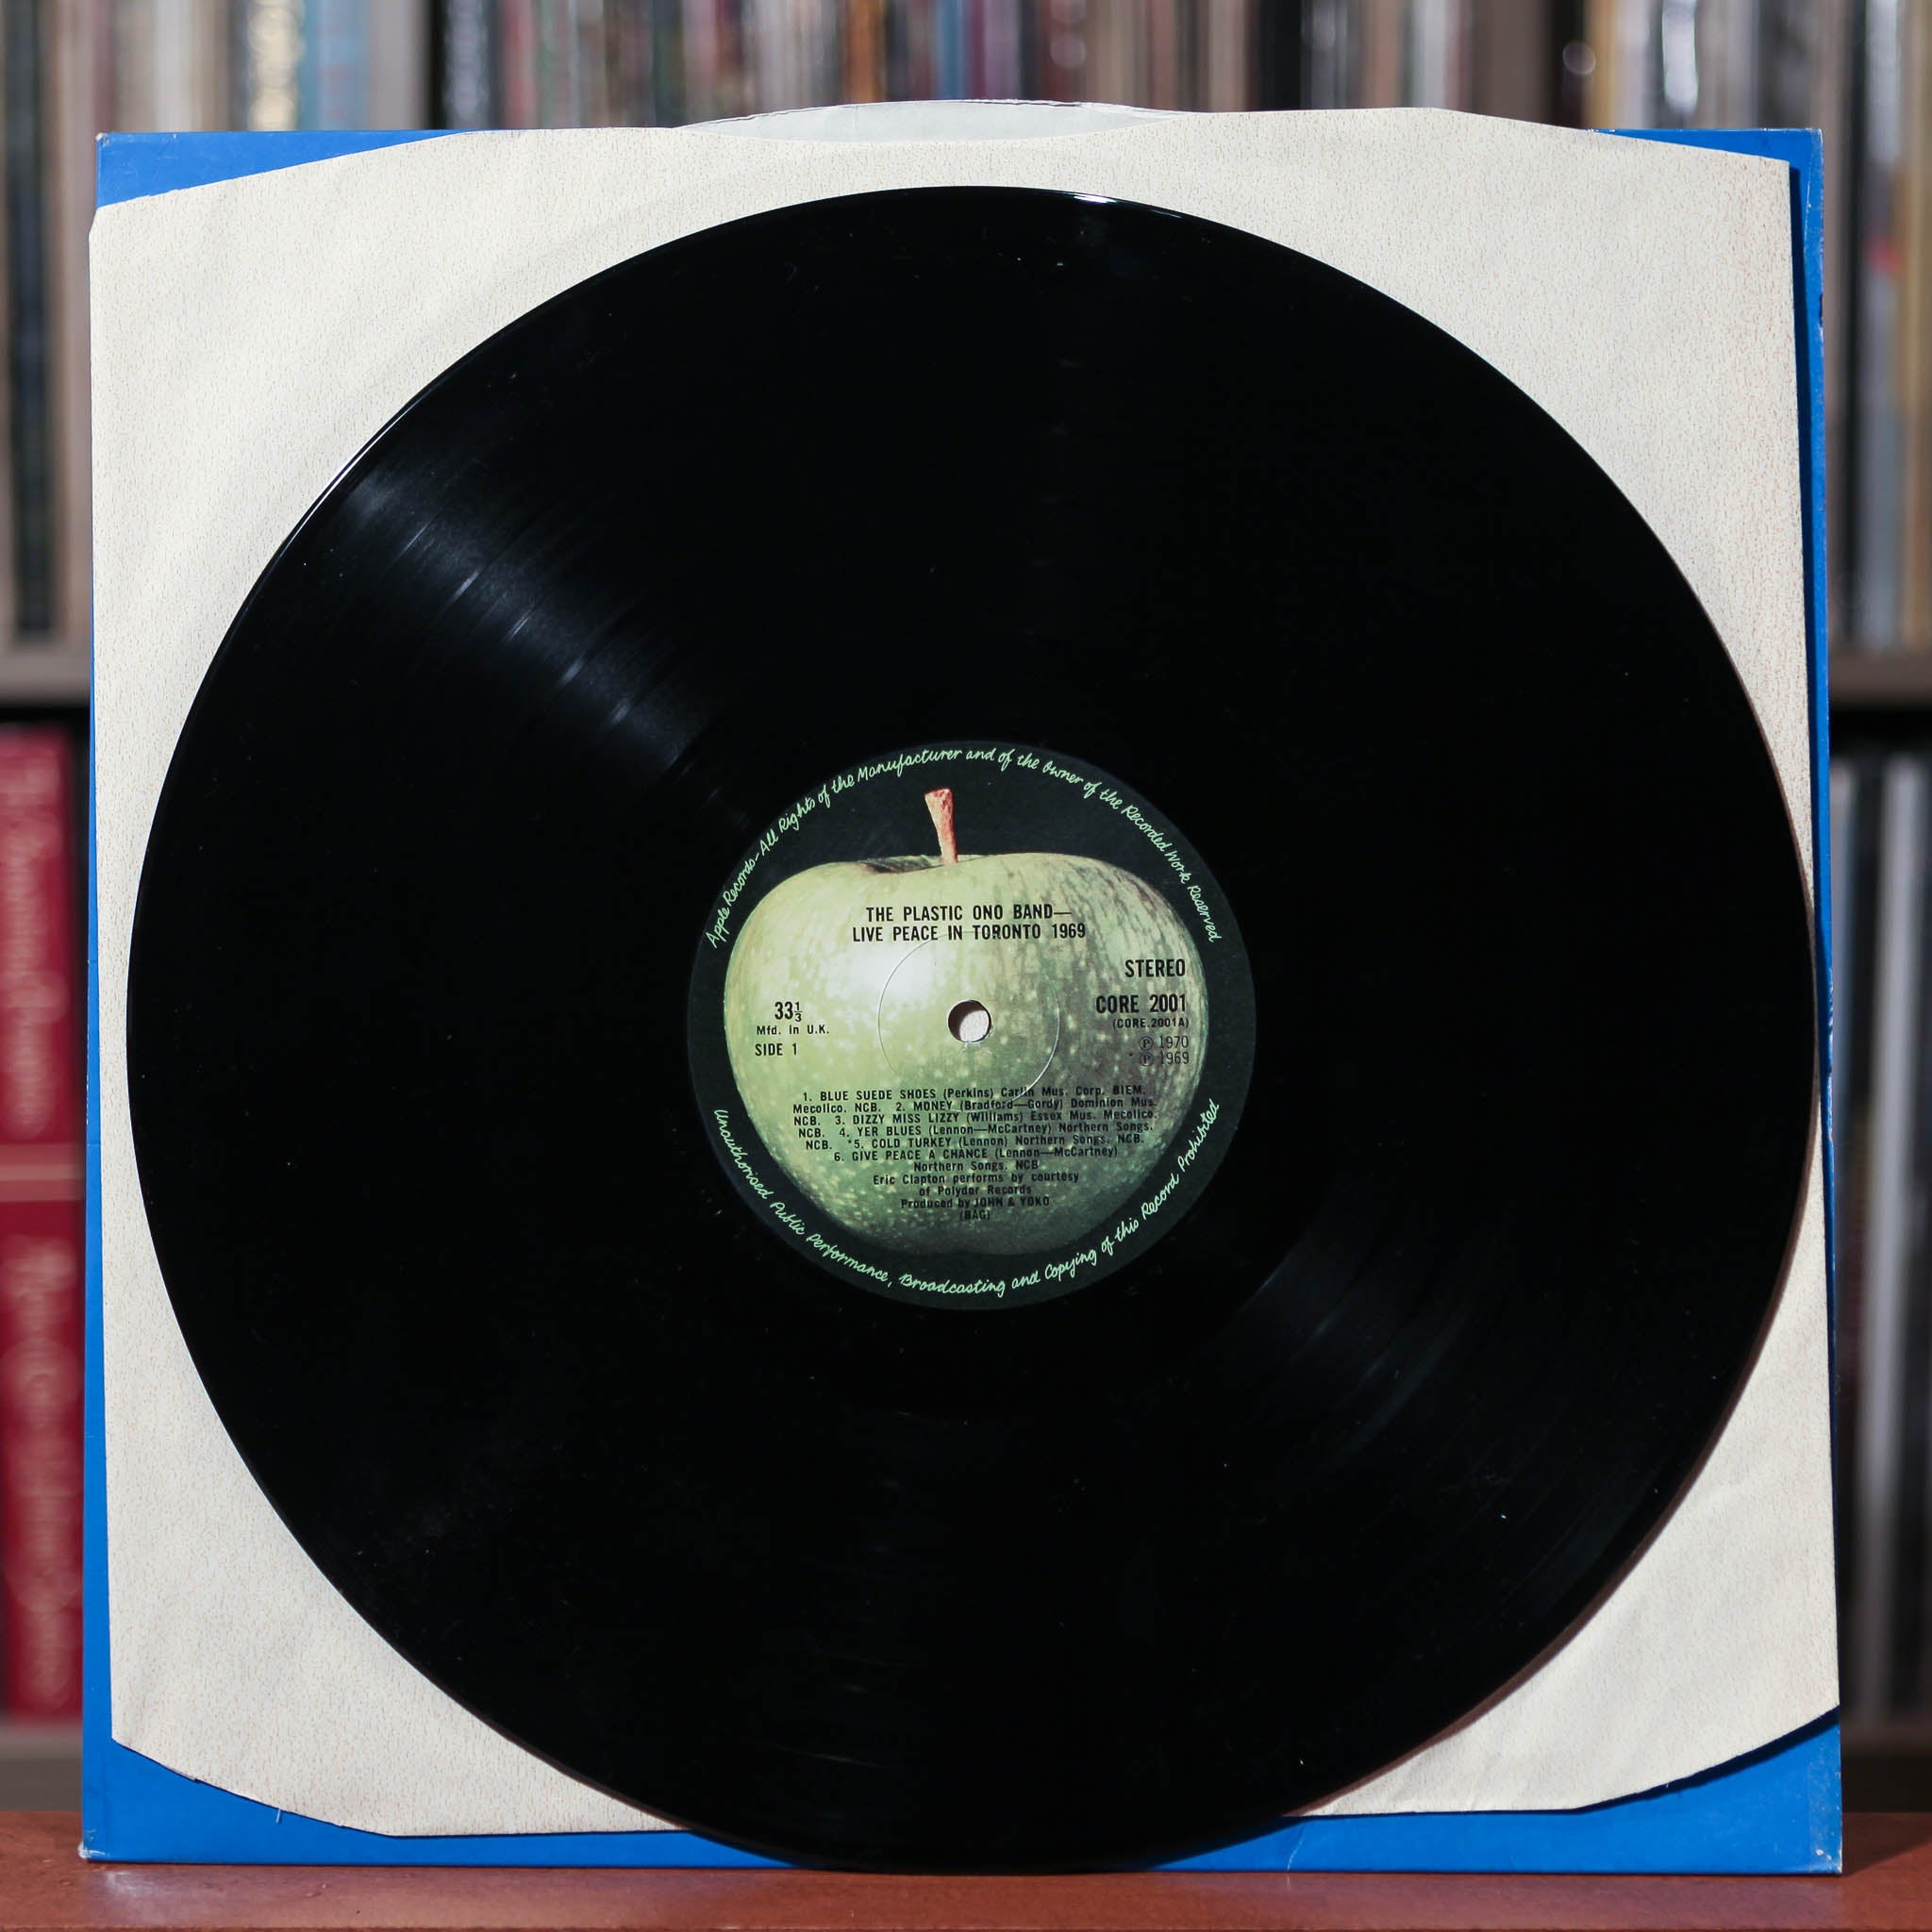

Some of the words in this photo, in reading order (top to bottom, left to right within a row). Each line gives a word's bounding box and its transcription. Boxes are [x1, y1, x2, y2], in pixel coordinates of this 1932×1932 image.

[706, 907, 730, 949] Apple
[778, 797, 816, 833] Rights
[818, 784, 831, 808] of
[831, 774, 855, 794] the
[858, 749, 964, 782] Manufacturer
[966, 747, 994, 761] and
[998, 748, 1016, 772] of
[1017, 753, 1040, 771] the
[1042, 760, 1084, 784] Owner
[1084, 781, 1102, 799] of
[1100, 789, 1123, 809] the
[1121, 805, 1166, 853] Recorded
[1164, 843, 1191, 884] Work
[1187, 885, 1223, 942] Reserved
[866, 907, 893, 923] THE
[903, 905, 963, 922] PLASTIC
[973, 904, 1004, 920] ONO
[852, 926, 883, 942] LIVE
[892, 924, 939, 941] PEACE
[948, 924, 963, 941] IN
[972, 924, 1041, 941] TORONTO
[1051, 922, 1086, 939] 1969
[1124, 958, 1186, 977] STEREO
[1095, 994, 1141, 1014] CORE
[1149, 992, 1186, 1012] 2001
[756, 1025, 781, 1036] Mfd.
[807, 1024, 830, 1035] U.K.
[755, 1042, 784, 1056] SIDE
[791, 1042, 798, 1056] 1
[1158, 1035, 1190, 1049] 1970
[1159, 1050, 1190, 1065] 1969
[803, 1091, 812, 1102] 1.
[820, 1091, 849, 1101] BLUE
[856, 1090, 892, 1100] SUEDE
[899, 1089, 937, 1099] SHOES
[943, 1087, 994, 1100] (Perkins)
[1041, 1086, 1068, 1097] Mus.
[1075, 1086, 1106, 1099] Corp.
[1112, 1085, 1146, 1096] BIEM.
[854, 1102, 881, 1113] NCB.
[895, 1101, 906, 1112] 2.
[913, 1101, 953, 1111] MONEY
[1071, 1097, 1124, 1108] Dominion
[1131, 1096, 1157, 1108] Mus.
[793, 1115, 821, 1126] NCB.
[834, 1114, 845, 1125] 3.
[852, 1114, 885, 1125] DIZZY
[892, 1112, 921, 1124] MISS
[928, 1112, 959, 1124] LIZZY
[966, 1111, 1024, 1124] (Williams)
[1030, 1110, 1062, 1122] Essex
[1070, 1110, 1096, 1121] Mus.
[798, 1127, 824, 1139] NCB.
[839, 1127, 850, 1138] 4.
[857, 1126, 878, 1137] YER
[886, 1125, 922, 1136] BLUES
[1058, 1122, 1108, 1133] Northern
[1116, 1122, 1154, 1133] Songs.
[806, 1140, 832, 1150] NCB.
[871, 1139, 900, 1149] COLD
[908, 1137, 952, 1148] TURKEY
[958, 1136, 1008, 1149] (Lennon)
[1015, 1135, 1065, 1145] Northern
[1073, 1134, 1109, 1146] Songs.
[1117, 1133, 1144, 1143] NCB.
[834, 1152, 844, 1162] 6.
[852, 1151, 878, 1161] GIVE
[886, 1149, 922, 1160] PEACE
[928, 1149, 936, 1159] A
[944, 1148, 988, 1159] CHANCE
[913, 1161, 964, 1172] Northern
[971, 1160, 1008, 1172] Songs.
[873, 1174, 895, 1185] Eric
[902, 1174, 945, 1186] Clapton
[953, 1173, 1004, 1186] performs
[1010, 1173, 1024, 1184] by
[1031, 1172, 1079, 1183] courtesy
[713, 1108, 774, 1200] Unauthorised
[769, 1201, 806, 1236] Public
[898, 1274, 1006, 1298] Broadcasting
[1011, 1271, 1041, 1290] and
[1044, 1249, 1097, 1282] Copying
[1101, 1236, 1115, 1257] of
[1114, 1217, 1140, 1242] this
[1141, 1173, 1179, 1220] Record
[1177, 1097, 1220, 1172] Prohibited
[919, 1186, 930, 1196] of
[938, 1185, 979, 1197] Polydor
[987, 1184, 1032, 1195] Records
[901, 1199, 953, 1208] Produced
[958, 1198, 971, 1208] by
[974, 1197, 1003, 1208] JOHN
[1008, 1196, 1015, 1207] &
[1020, 1196, 1050, 1207] YOKO
[958, 1208, 991, 1221] (BAG)
